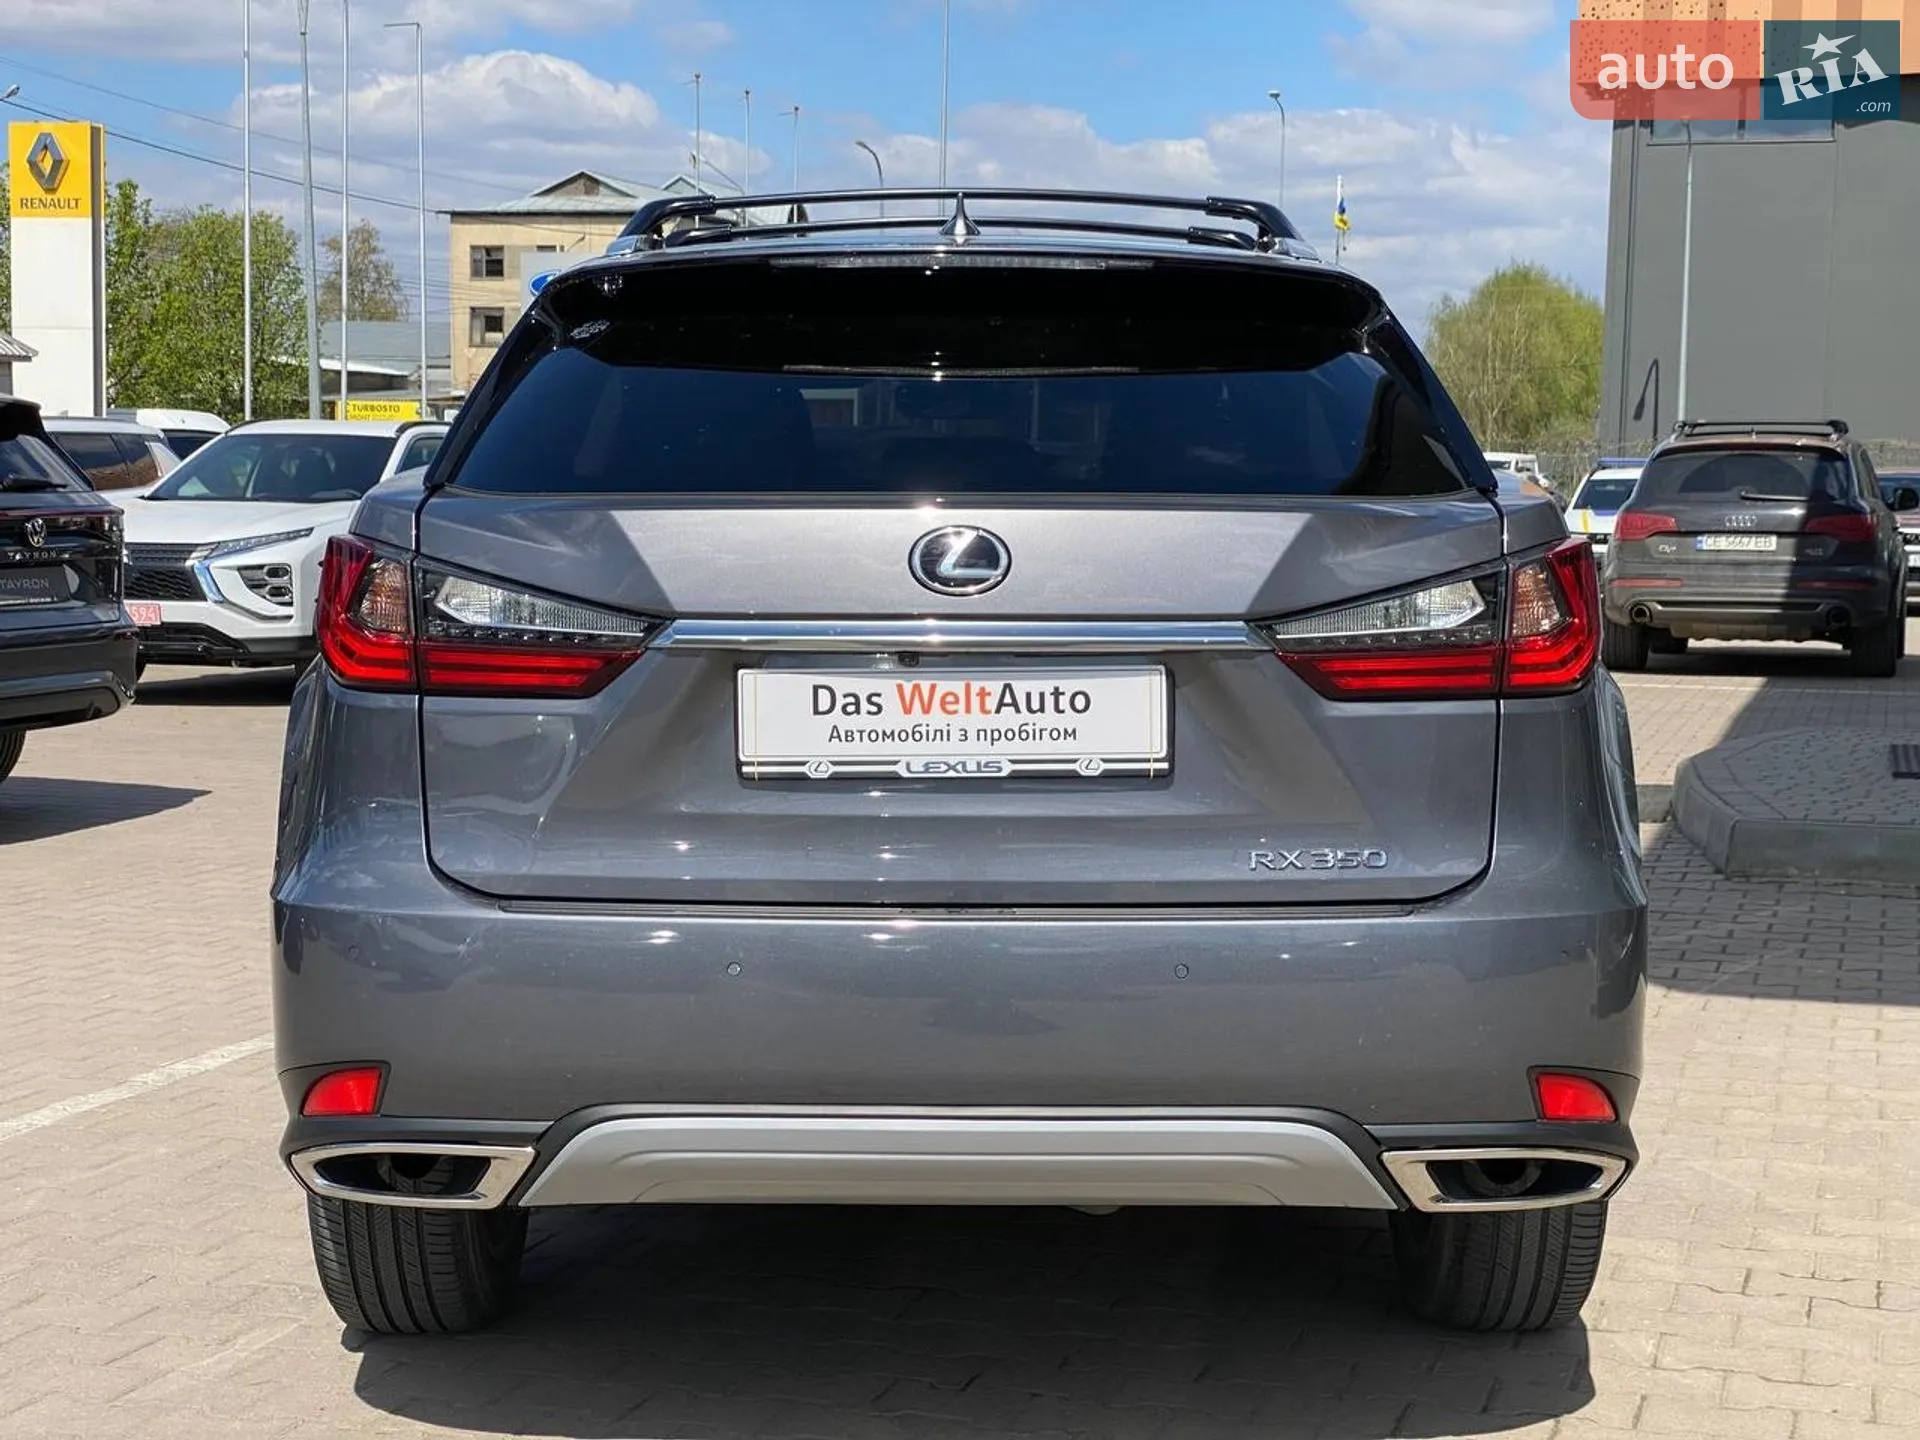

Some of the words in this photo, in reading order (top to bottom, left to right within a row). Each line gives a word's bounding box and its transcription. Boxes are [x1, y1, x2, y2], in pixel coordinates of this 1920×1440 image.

[20, 198, 81, 210] RENAULT
[352, 403, 400, 413] TURBOSTO
[8, 550, 57, 560] TAYRON
[0, 577, 49, 589] TAYRON
[812, 684, 884, 716] Das
[896, 682, 1091, 716] WeltAuto
[828, 723, 952, 743] Автомобілі
[958, 728, 969, 743] з
[976, 722, 1077, 746] пробігом
[905, 760, 1003, 775] LEXUS
